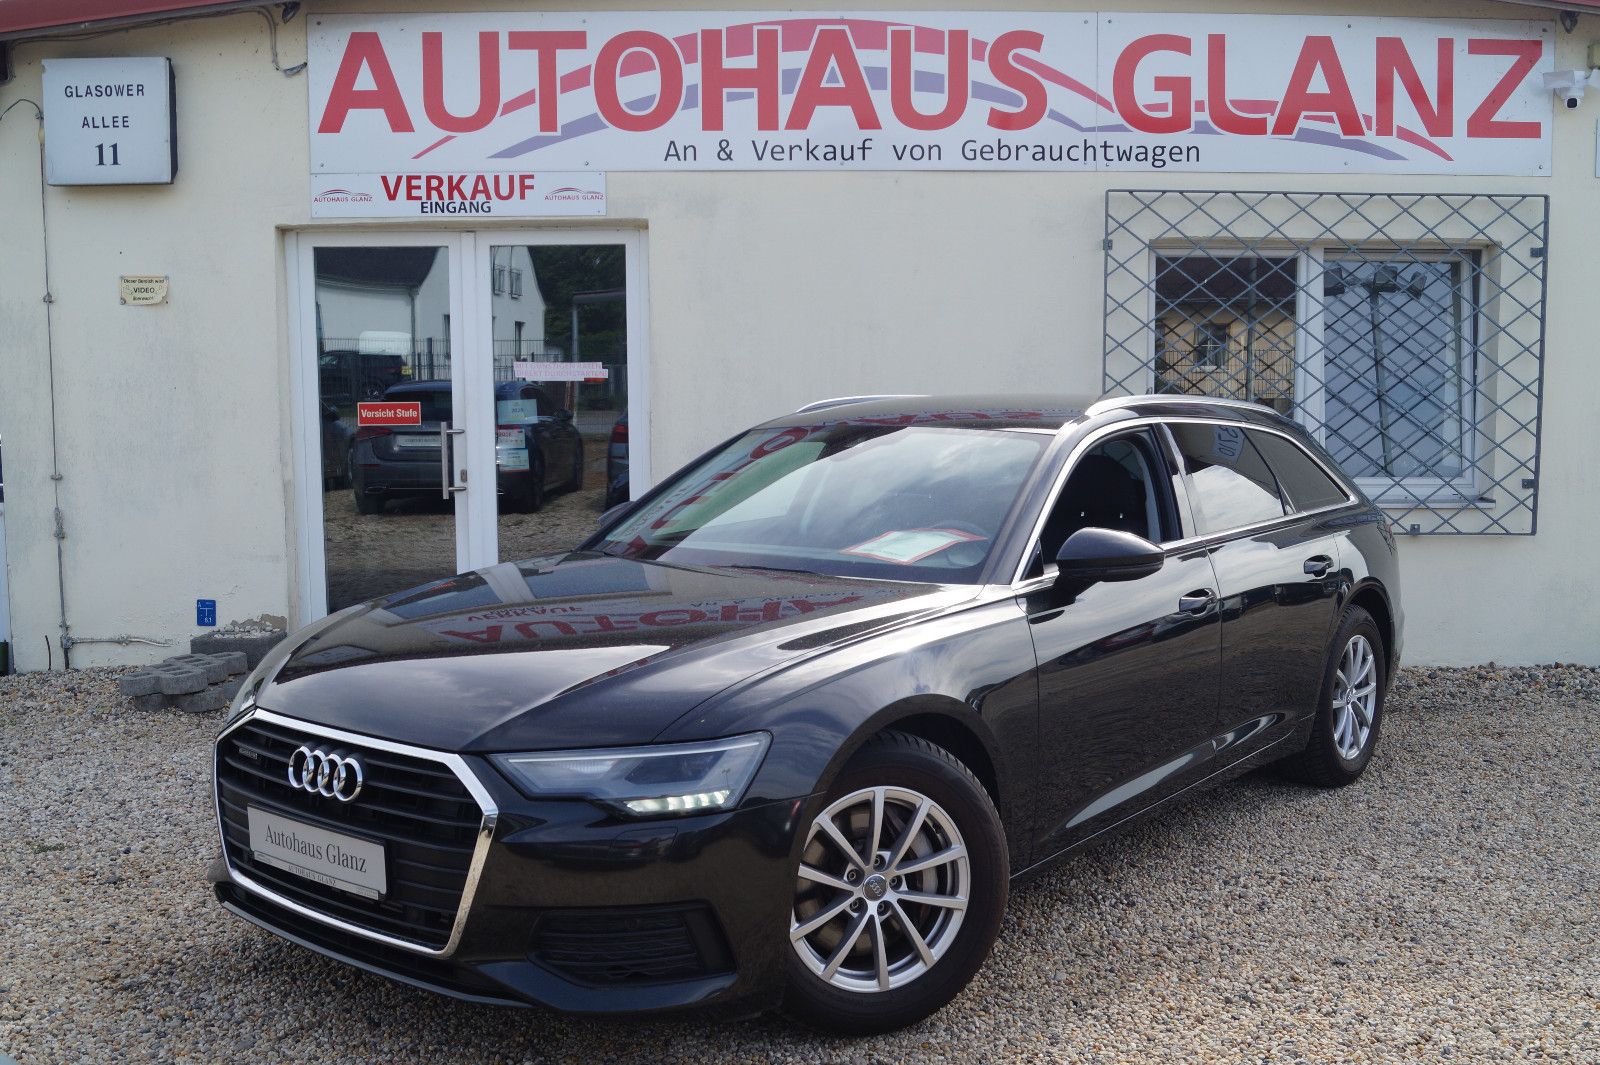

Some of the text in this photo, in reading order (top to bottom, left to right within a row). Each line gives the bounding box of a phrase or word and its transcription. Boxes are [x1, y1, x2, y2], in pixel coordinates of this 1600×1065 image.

[64, 84, 145, 98] GLASOWER
[317, 25, 1543, 139] AUTOHAUS GLANZ
[81, 116, 130, 129] ALLEE
[95, 142, 121, 167] 11
[664, 137, 1201, 168] An & Verkauf von Gebrauchtwagen
[380, 174, 535, 201] VERKAUF
[420, 201, 492, 214] EINGANG
[361, 409, 418, 418] Vorsicht Stufe
[265, 824, 367, 873] Autohaus Glanz
